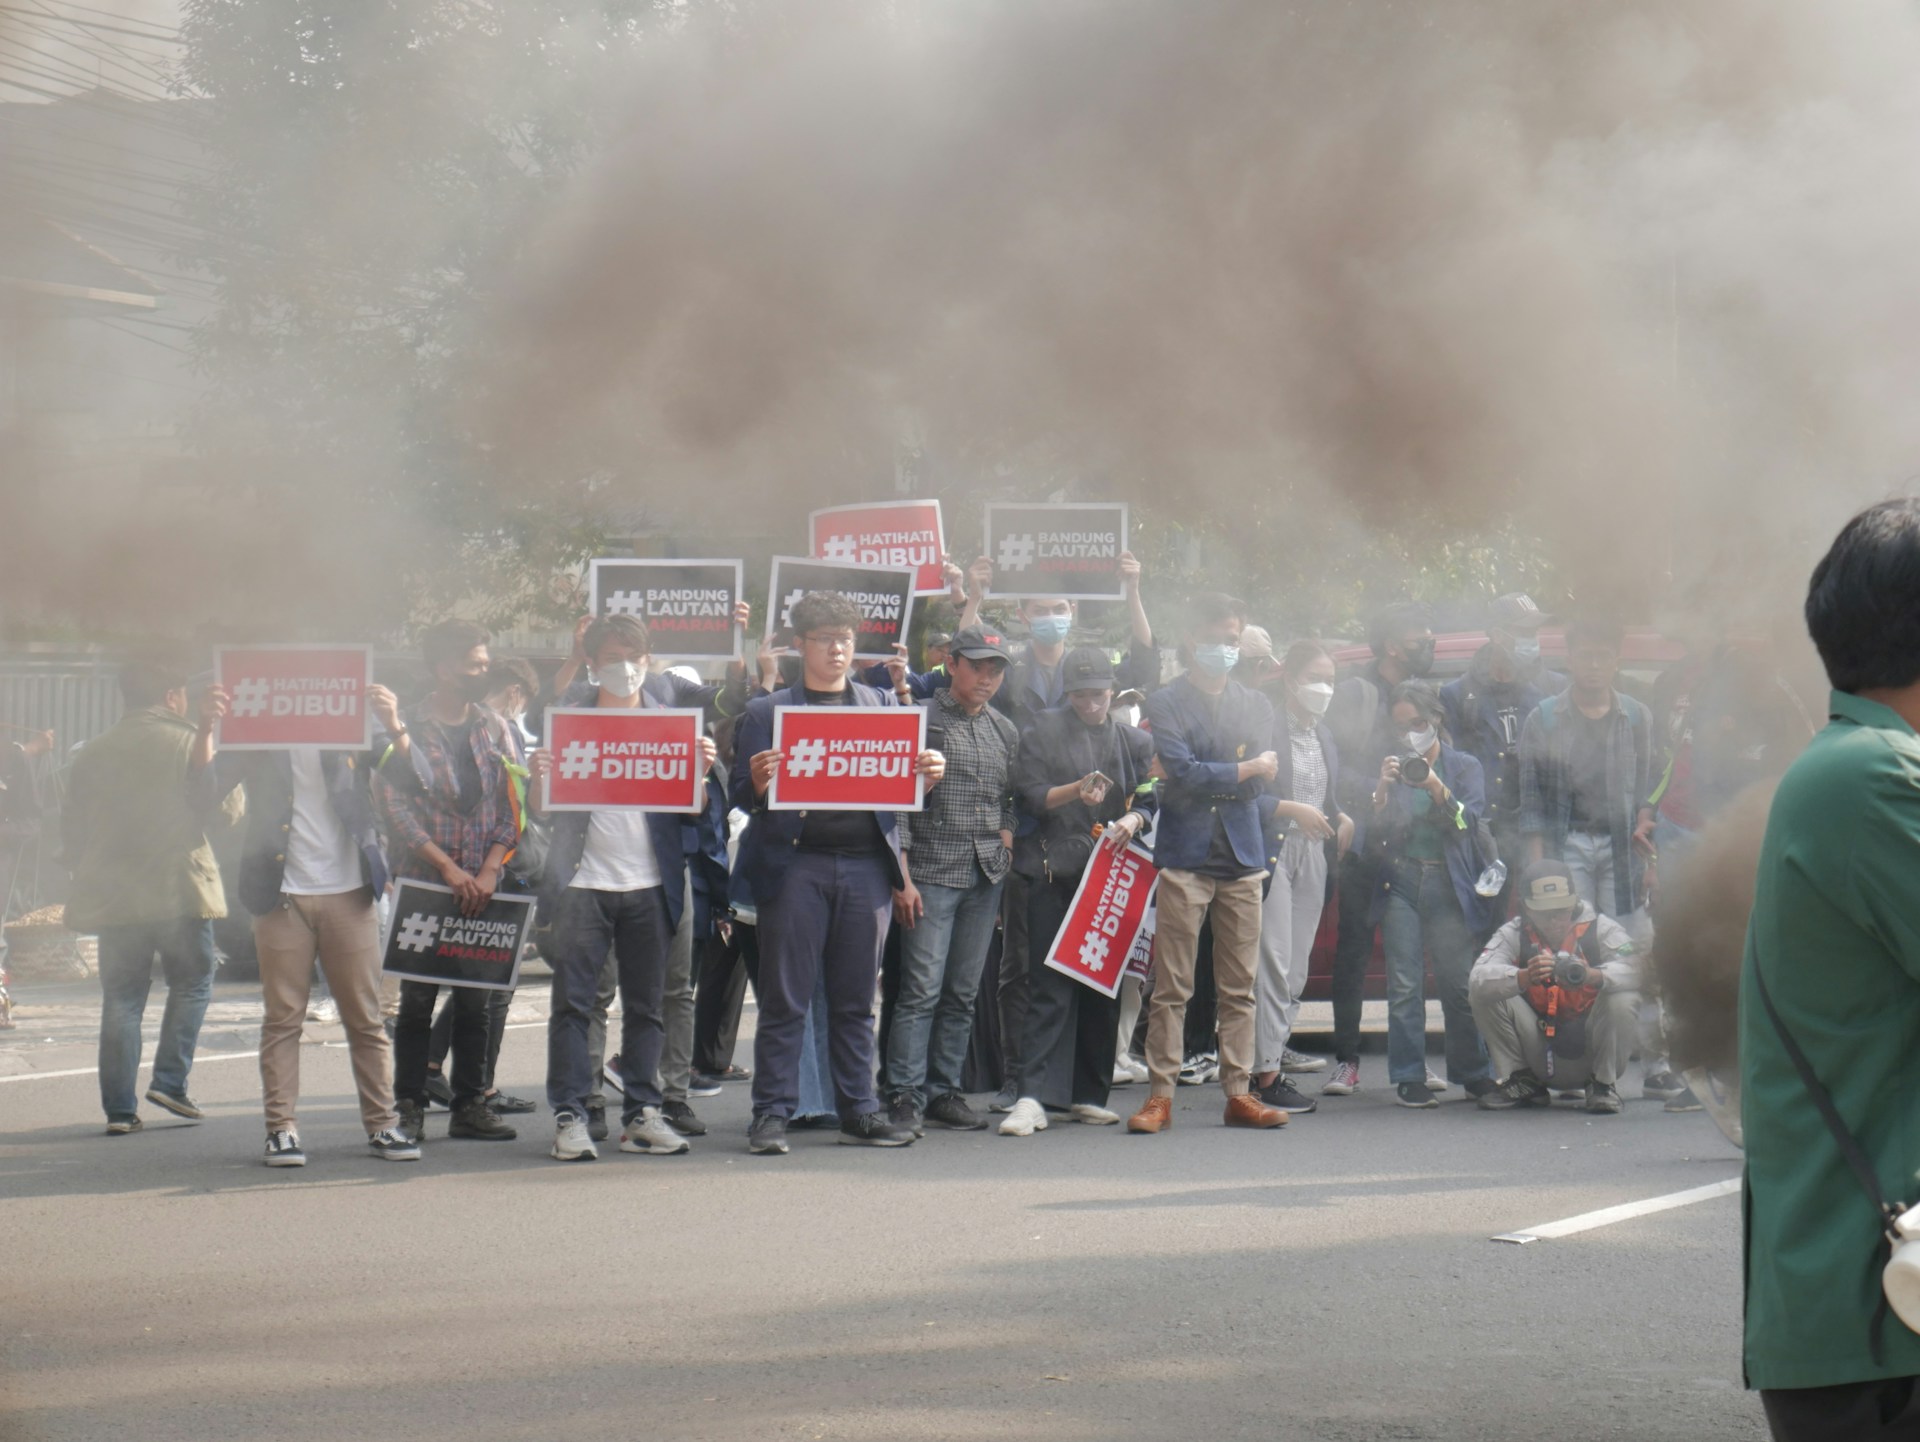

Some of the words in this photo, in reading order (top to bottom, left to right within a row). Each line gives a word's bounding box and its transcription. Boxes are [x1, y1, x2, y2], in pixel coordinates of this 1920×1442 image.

[860, 530, 934, 546] HATIHATI
[1038, 532, 1115, 543] BANDUNG
[860, 545, 936, 567] DIBUI
[1038, 544, 1115, 558] LAUTAN
[647, 589, 728, 602] BANDUNG
[647, 602, 728, 616] LAUTAN
[648, 618, 729, 632] AMARAH
[272, 677, 357, 691] HATIHATI
[271, 694, 357, 716] DIBUI
[602, 741, 688, 756] HATIHATI
[829, 739, 911, 753] HATIHATI
[601, 758, 688, 781] DIBUI
[827, 756, 910, 778] DIBUI
[1102, 859, 1140, 937] DIBUI
[442, 916, 517, 934] BANDUNG
[439, 928, 515, 948] LAUTAN
[436, 944, 511, 962] AMARAH
